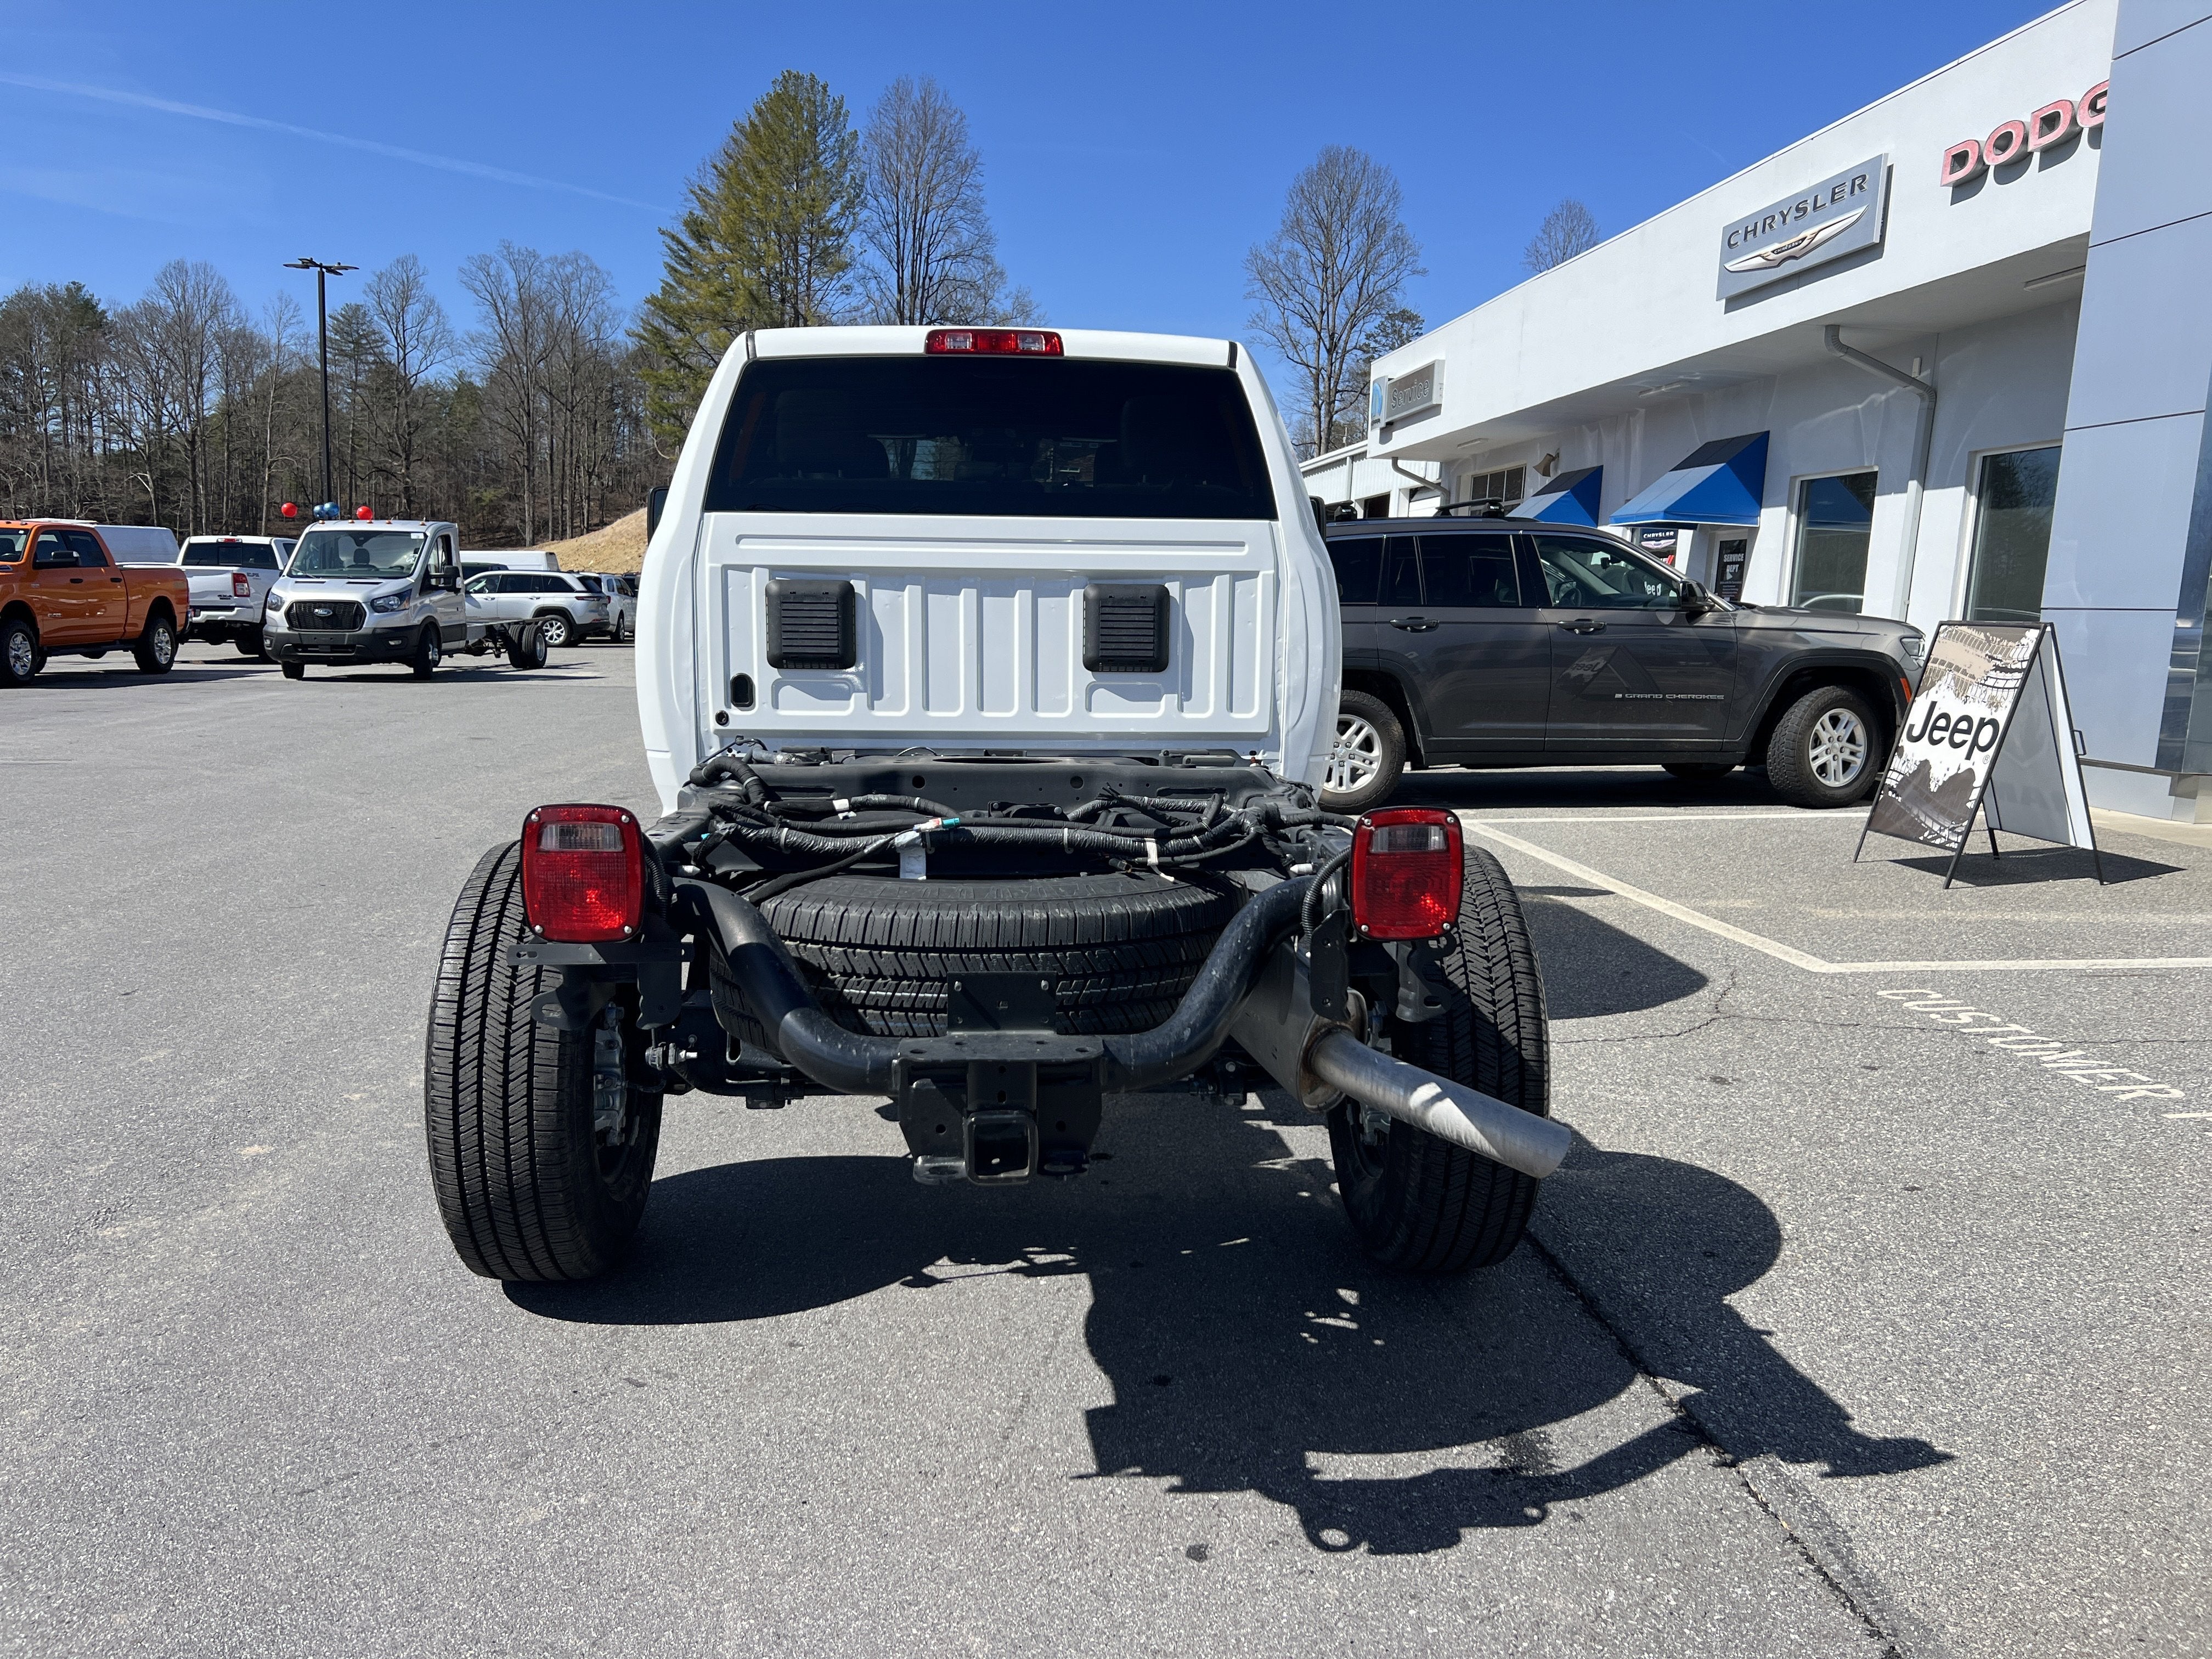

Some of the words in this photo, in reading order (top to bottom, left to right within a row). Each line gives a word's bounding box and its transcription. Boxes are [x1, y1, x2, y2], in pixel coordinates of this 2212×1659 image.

[1728, 173, 1867, 249] CHRYSLER
[1391, 379, 1430, 410] Service
[1724, 553, 1745, 562] SERVICE
[1726, 565, 1739, 573] DEPT
[1906, 701, 2000, 760] Jeep
[1876, 989, 2186, 1102] CUSTOMER
